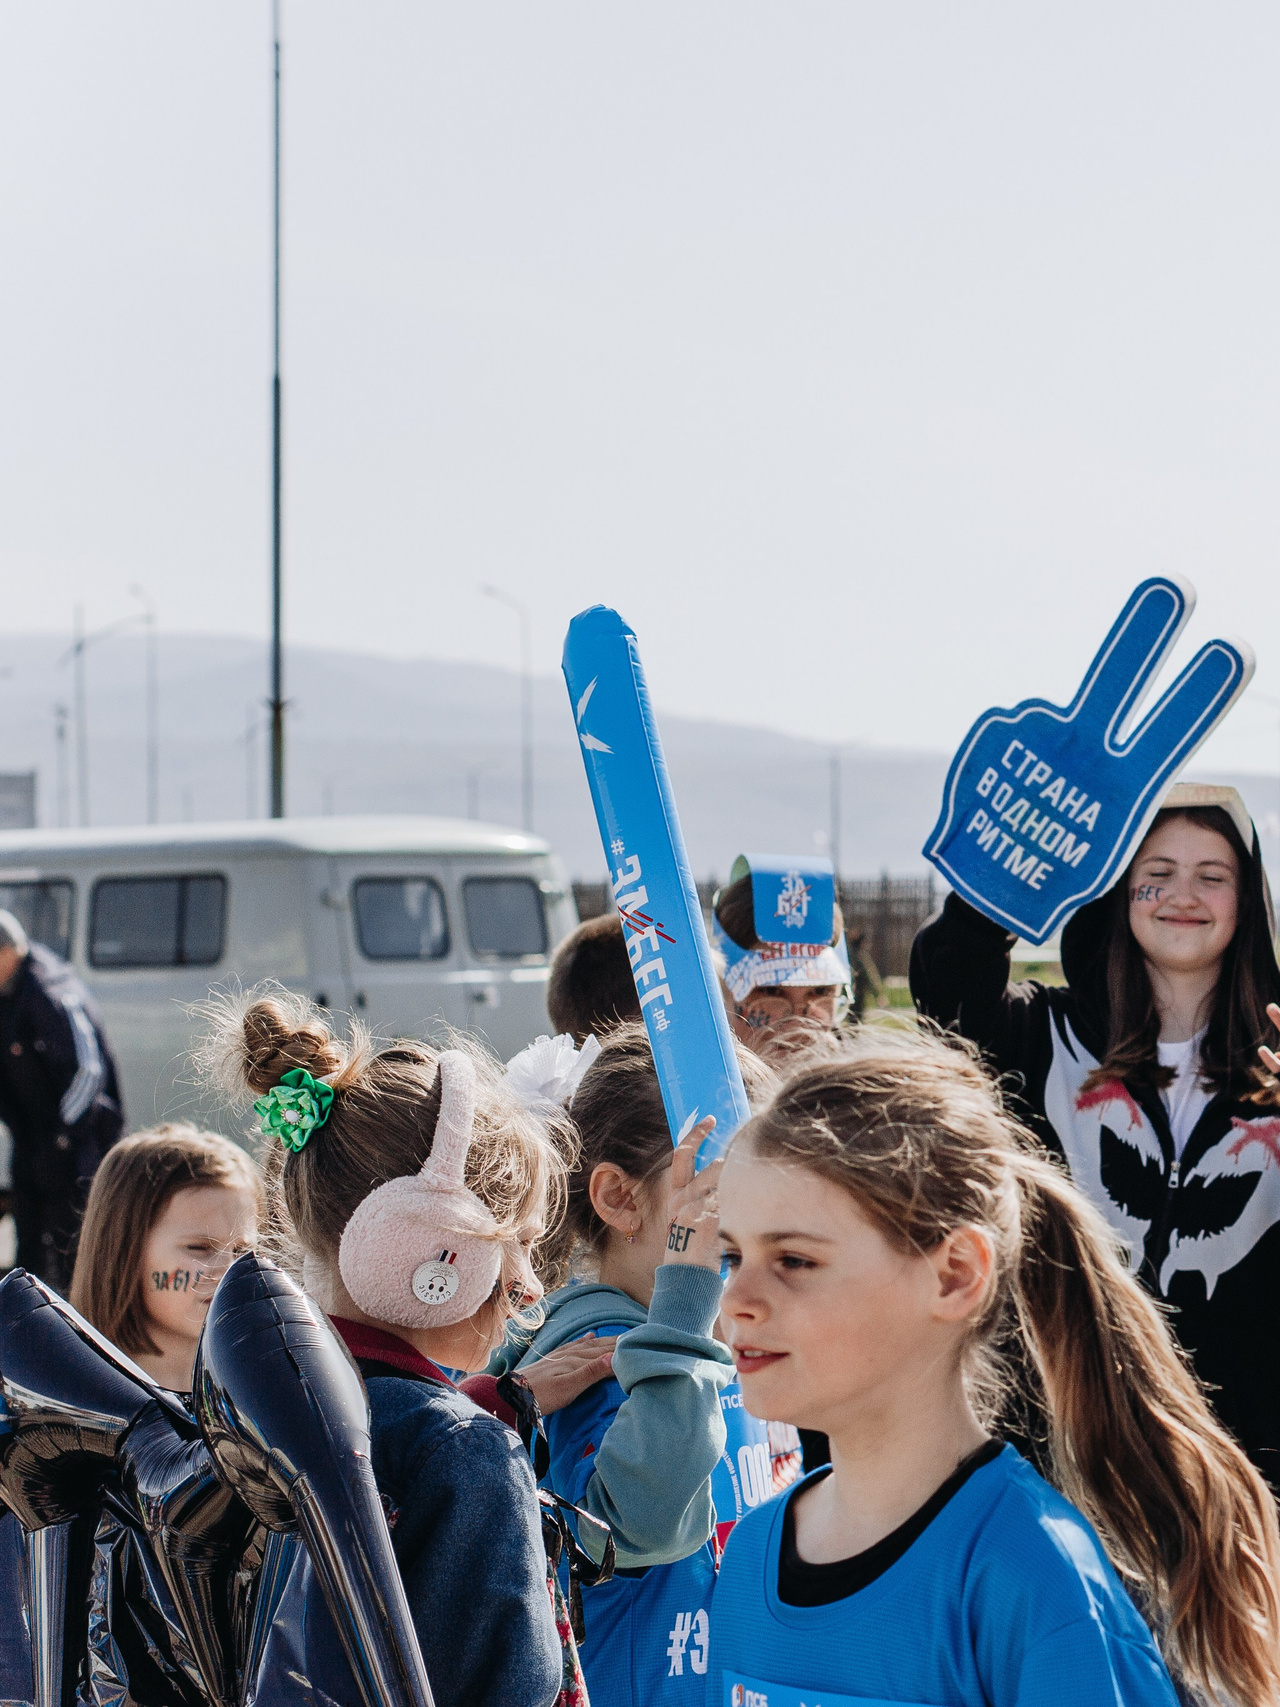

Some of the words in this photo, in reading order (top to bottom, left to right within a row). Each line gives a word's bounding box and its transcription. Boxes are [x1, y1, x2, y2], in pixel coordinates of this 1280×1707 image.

[976, 767, 999, 798] В
[991, 781, 1091, 869] ОДНОМ
[1001, 739, 1102, 832] СТРАНА
[966, 808, 1054, 891] РИТМЕ
[667, 1223, 696, 1252] БЕГ
[418, 1284, 452, 1301] CLASSIC
